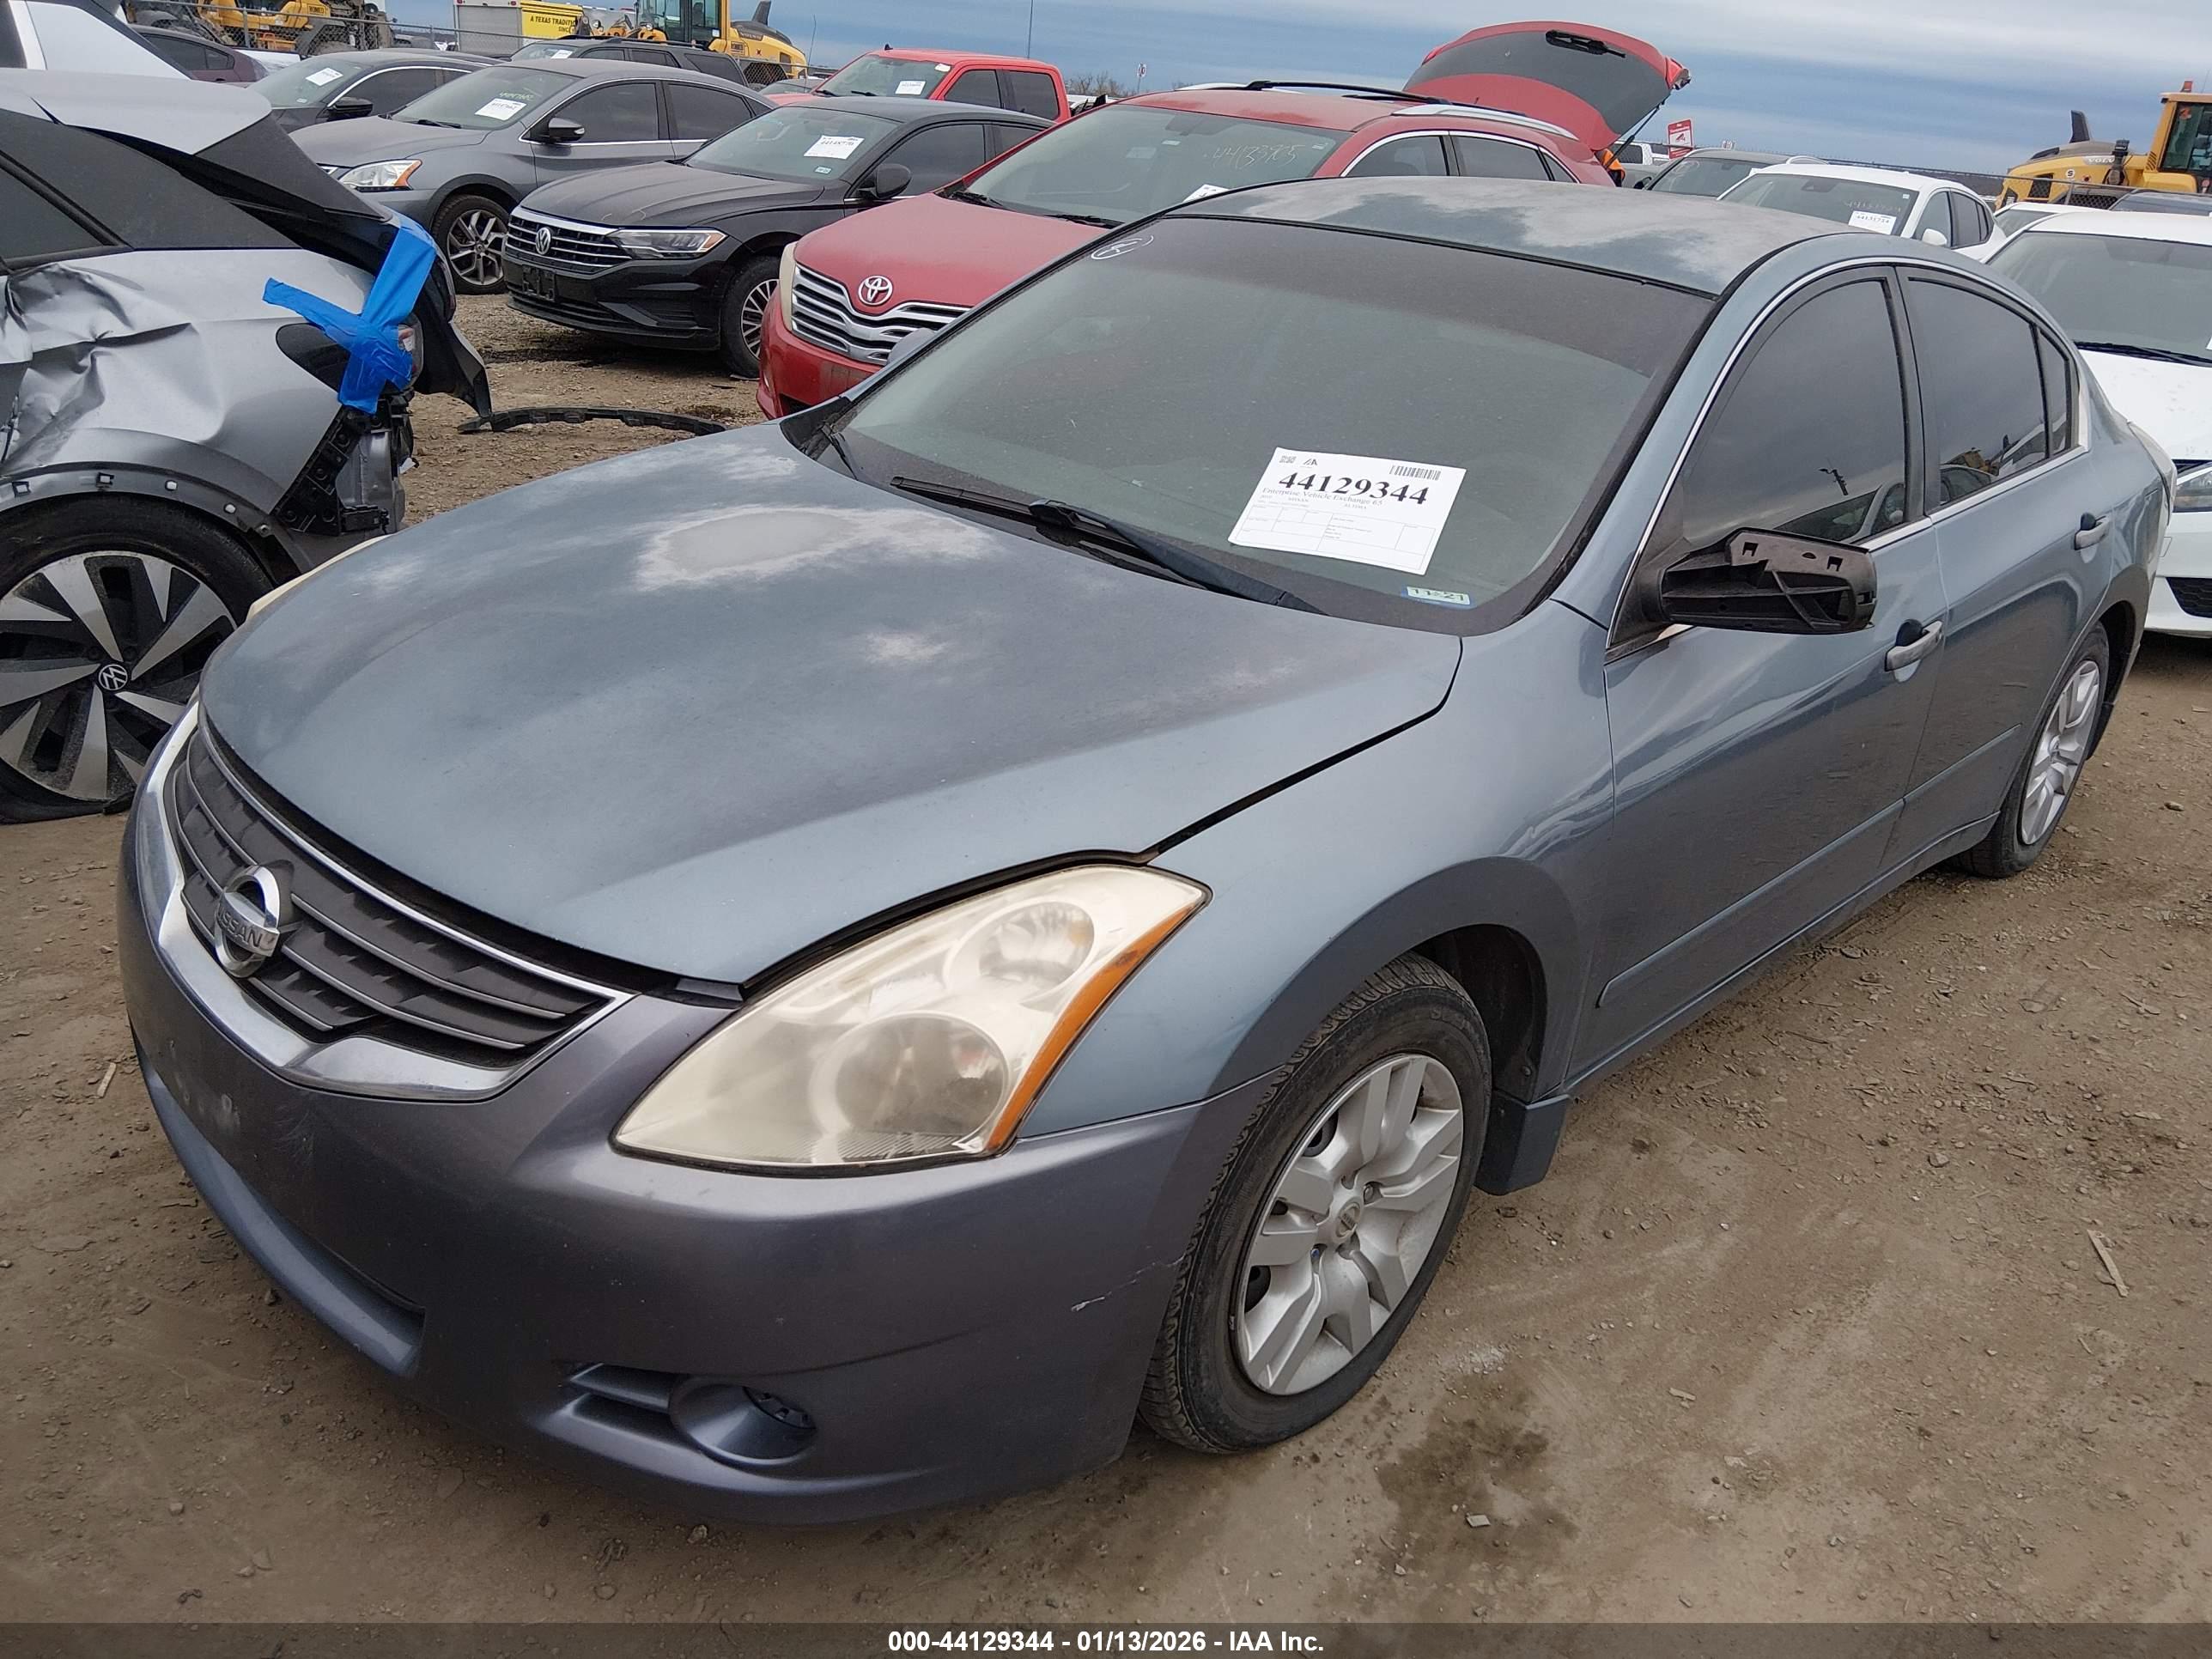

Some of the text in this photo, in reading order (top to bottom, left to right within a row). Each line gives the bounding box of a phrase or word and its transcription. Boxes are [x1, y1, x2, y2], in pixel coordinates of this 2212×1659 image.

[1262, 487, 1300, 496] Enterprise
[1304, 491, 1332, 500] Vehicle
[1333, 495, 1370, 505] Exchange
[1279, 471, 1429, 505] 44129344
